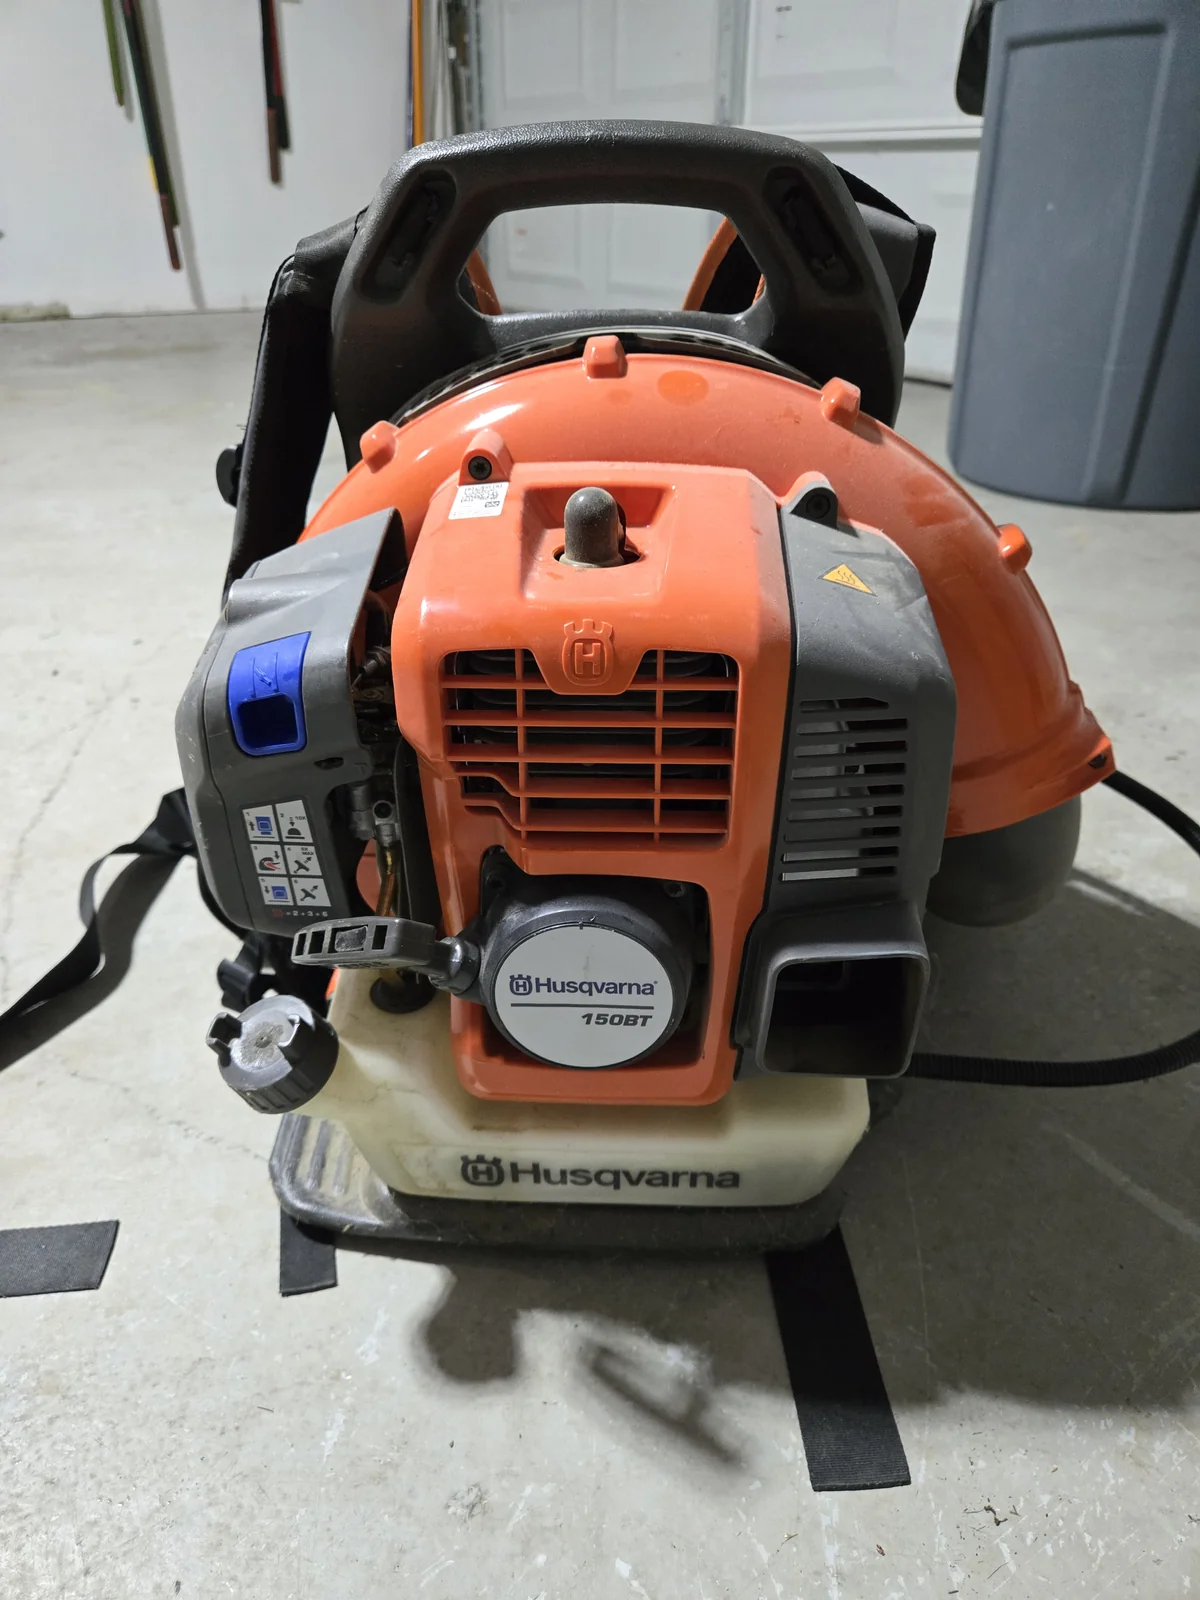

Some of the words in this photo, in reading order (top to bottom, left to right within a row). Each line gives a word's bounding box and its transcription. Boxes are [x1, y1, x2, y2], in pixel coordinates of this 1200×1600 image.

[535, 977, 655, 997] Husqvarna
[581, 1013, 653, 1027] 150BT
[510, 1162, 740, 1190] Husqvarna
